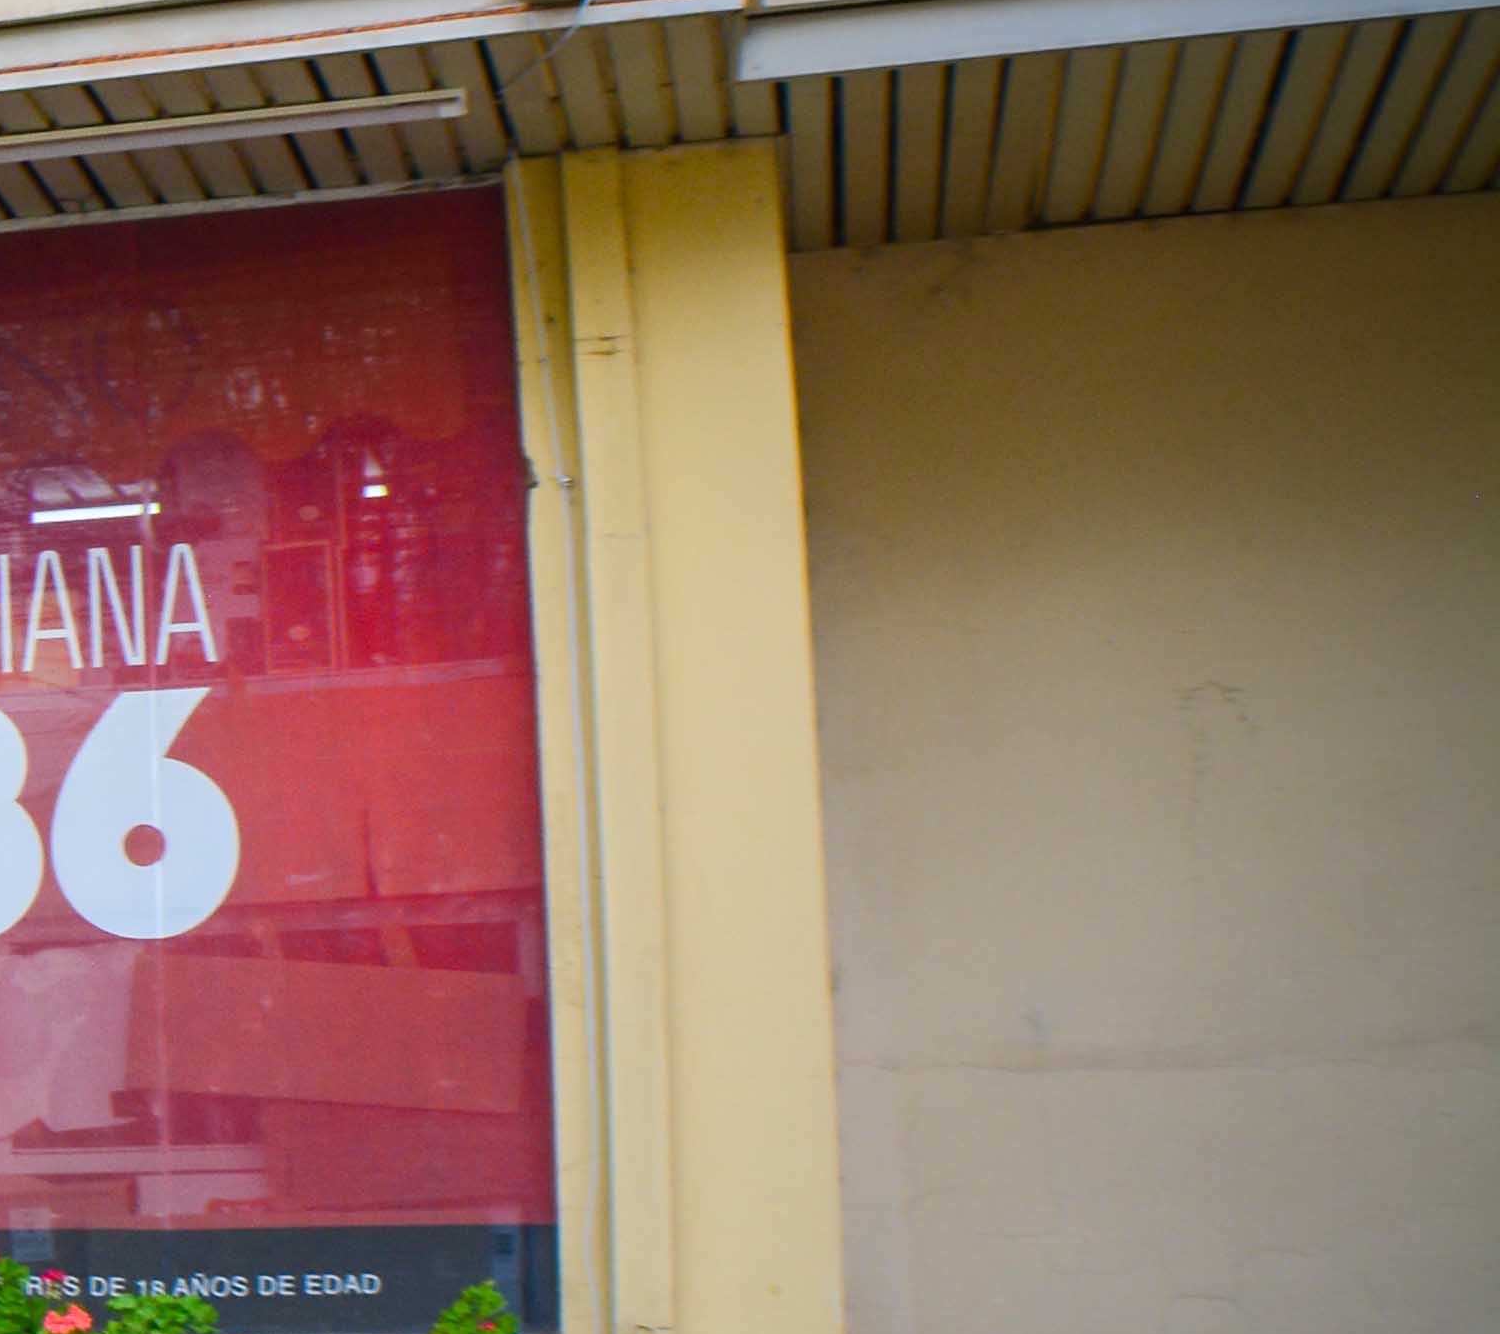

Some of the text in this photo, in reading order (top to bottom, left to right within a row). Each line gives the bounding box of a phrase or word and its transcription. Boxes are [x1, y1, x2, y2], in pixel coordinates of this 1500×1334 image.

[88, 1275, 126, 1297] DE
[172, 1272, 249, 1298] AÑOS
[257, 1274, 296, 1296] DE
[304, 1272, 382, 1296] EDAD
